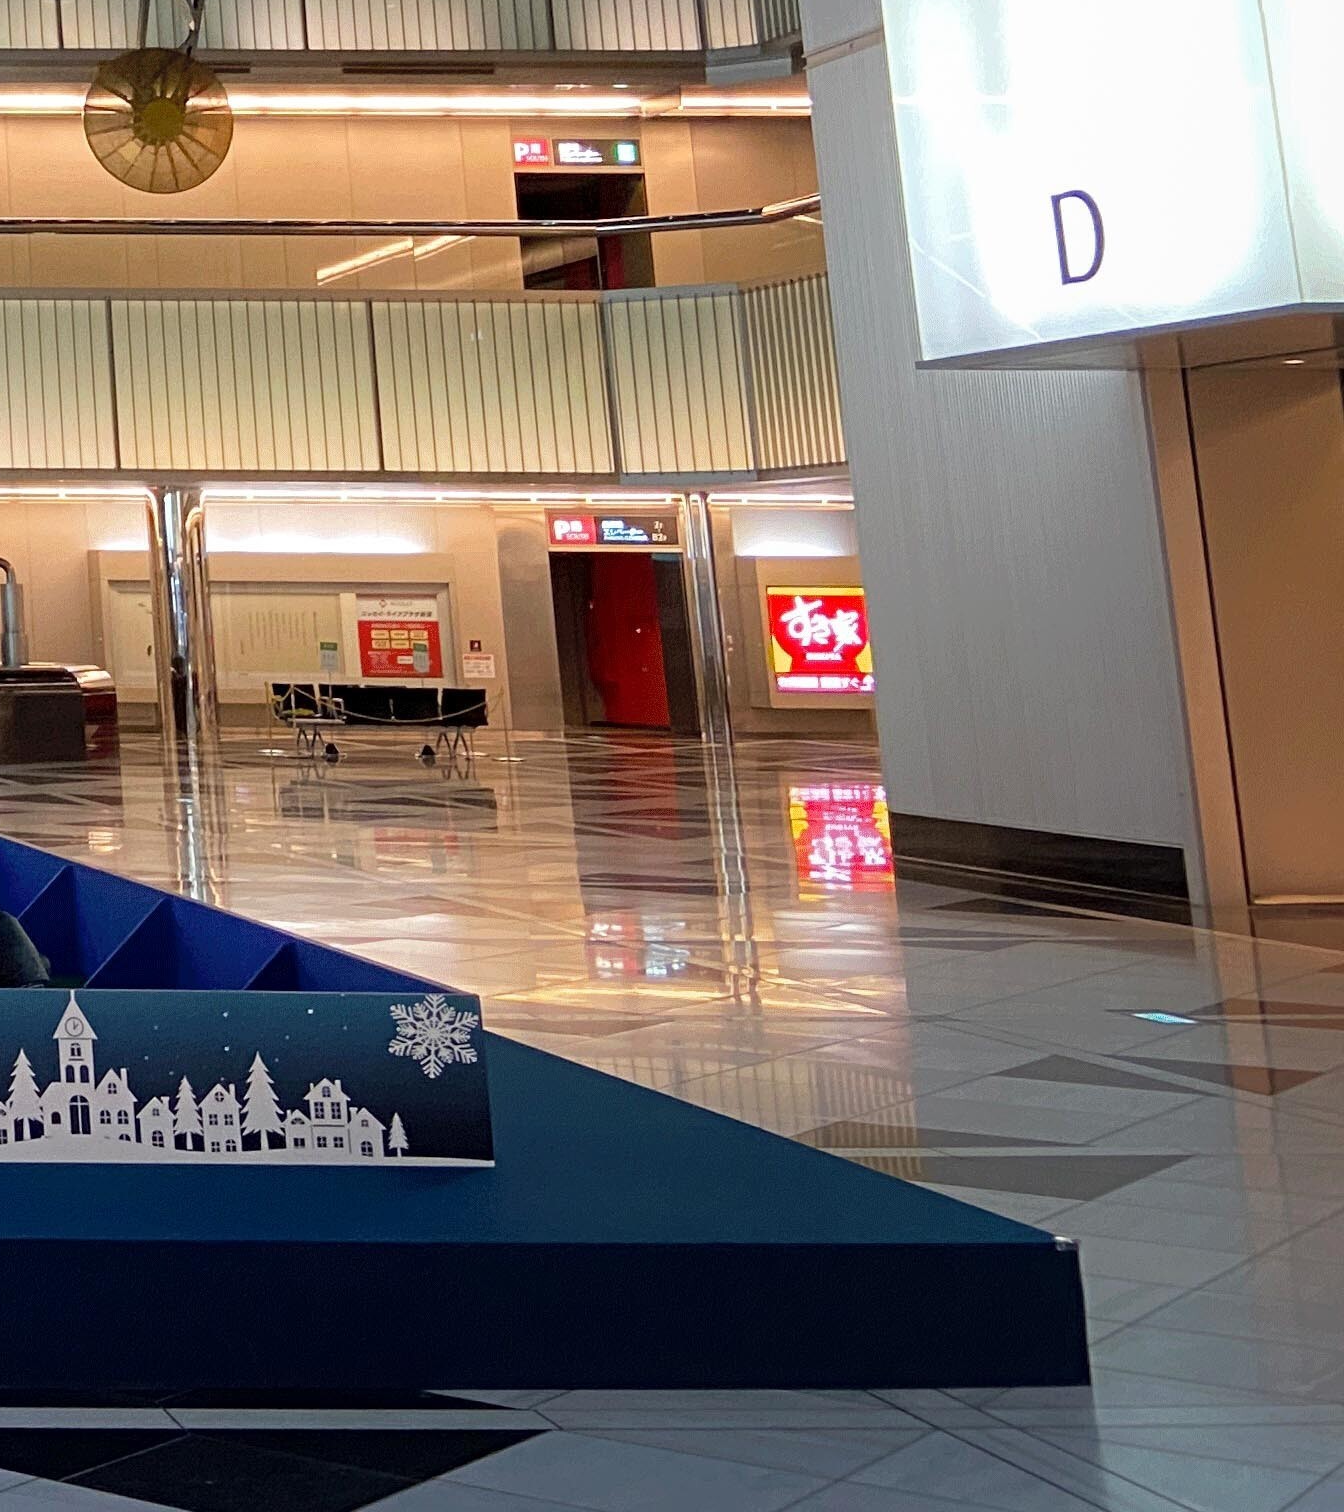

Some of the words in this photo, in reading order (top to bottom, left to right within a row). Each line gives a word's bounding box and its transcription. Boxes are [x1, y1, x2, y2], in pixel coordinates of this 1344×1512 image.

[1051, 189, 1105, 285] D
[780, 595, 862, 652] すき家
